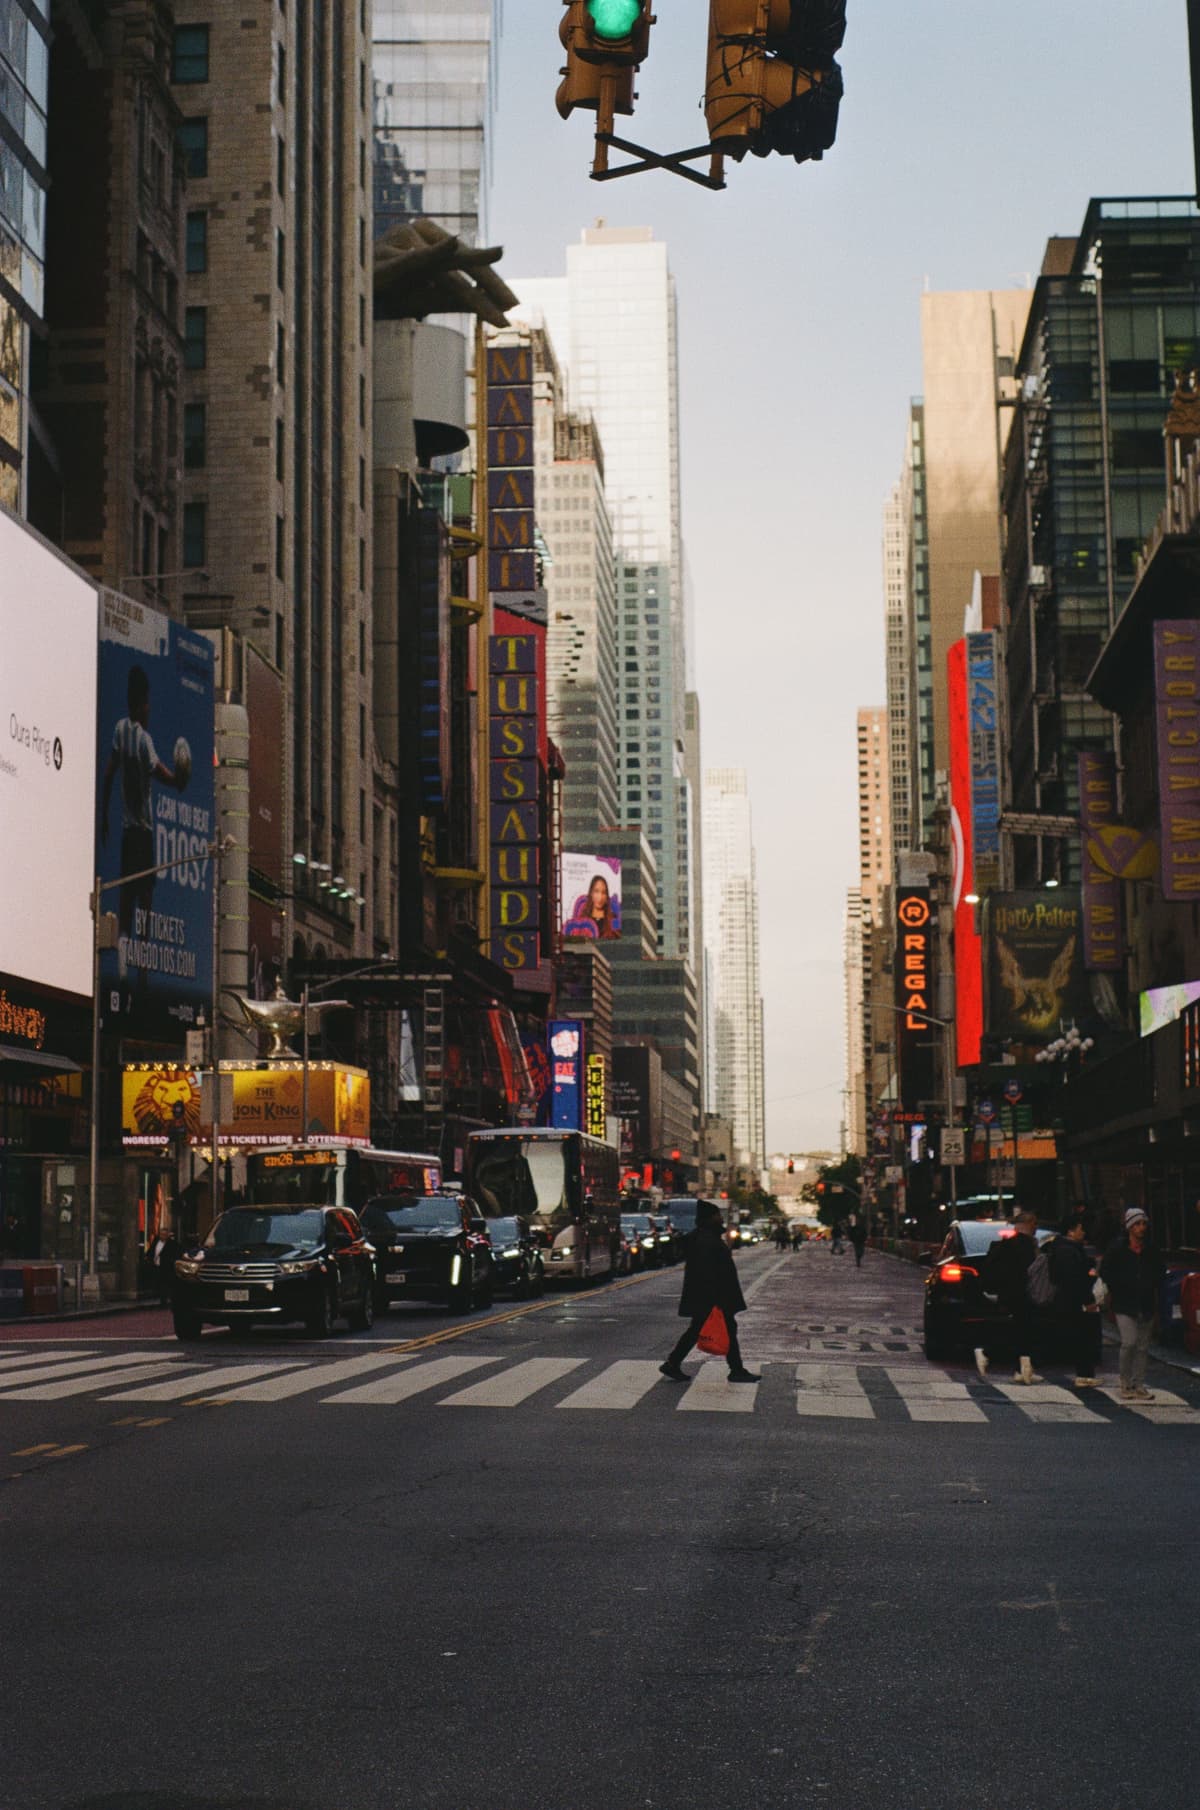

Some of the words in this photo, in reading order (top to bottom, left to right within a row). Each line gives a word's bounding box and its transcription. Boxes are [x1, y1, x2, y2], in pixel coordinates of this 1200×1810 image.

[491, 351, 531, 590] MADAME
[968, 633, 994, 680] NEW
[972, 682, 997, 732] 42
[1163, 631, 1200, 792] VICTORY
[10, 713, 30, 748] Oura
[32, 726, 50, 766] Ring
[177, 801, 192, 827] YOU
[193, 806, 209, 832] BEAT
[1086, 760, 1113, 885] VTORY
[1171, 816, 1200, 892] NEW
[136, 908, 148, 935] BY
[149, 911, 185, 945] TICKETS
[996, 906, 1034, 932] Harry
[1035, 903, 1078, 929] Potter
[1091, 904, 1116, 964] NEW
[904, 935, 928, 1030] REGAL
[234, 1104, 261, 1119] ION
[264, 1102, 300, 1120] KING
[255, 1087, 275, 1097] THE
[122, 1136, 169, 1144] INGRESSO
[231, 1135, 267, 1144] TICKETS
[269, 1135, 293, 1145] HERE
[943, 1142, 962, 1154] 25
